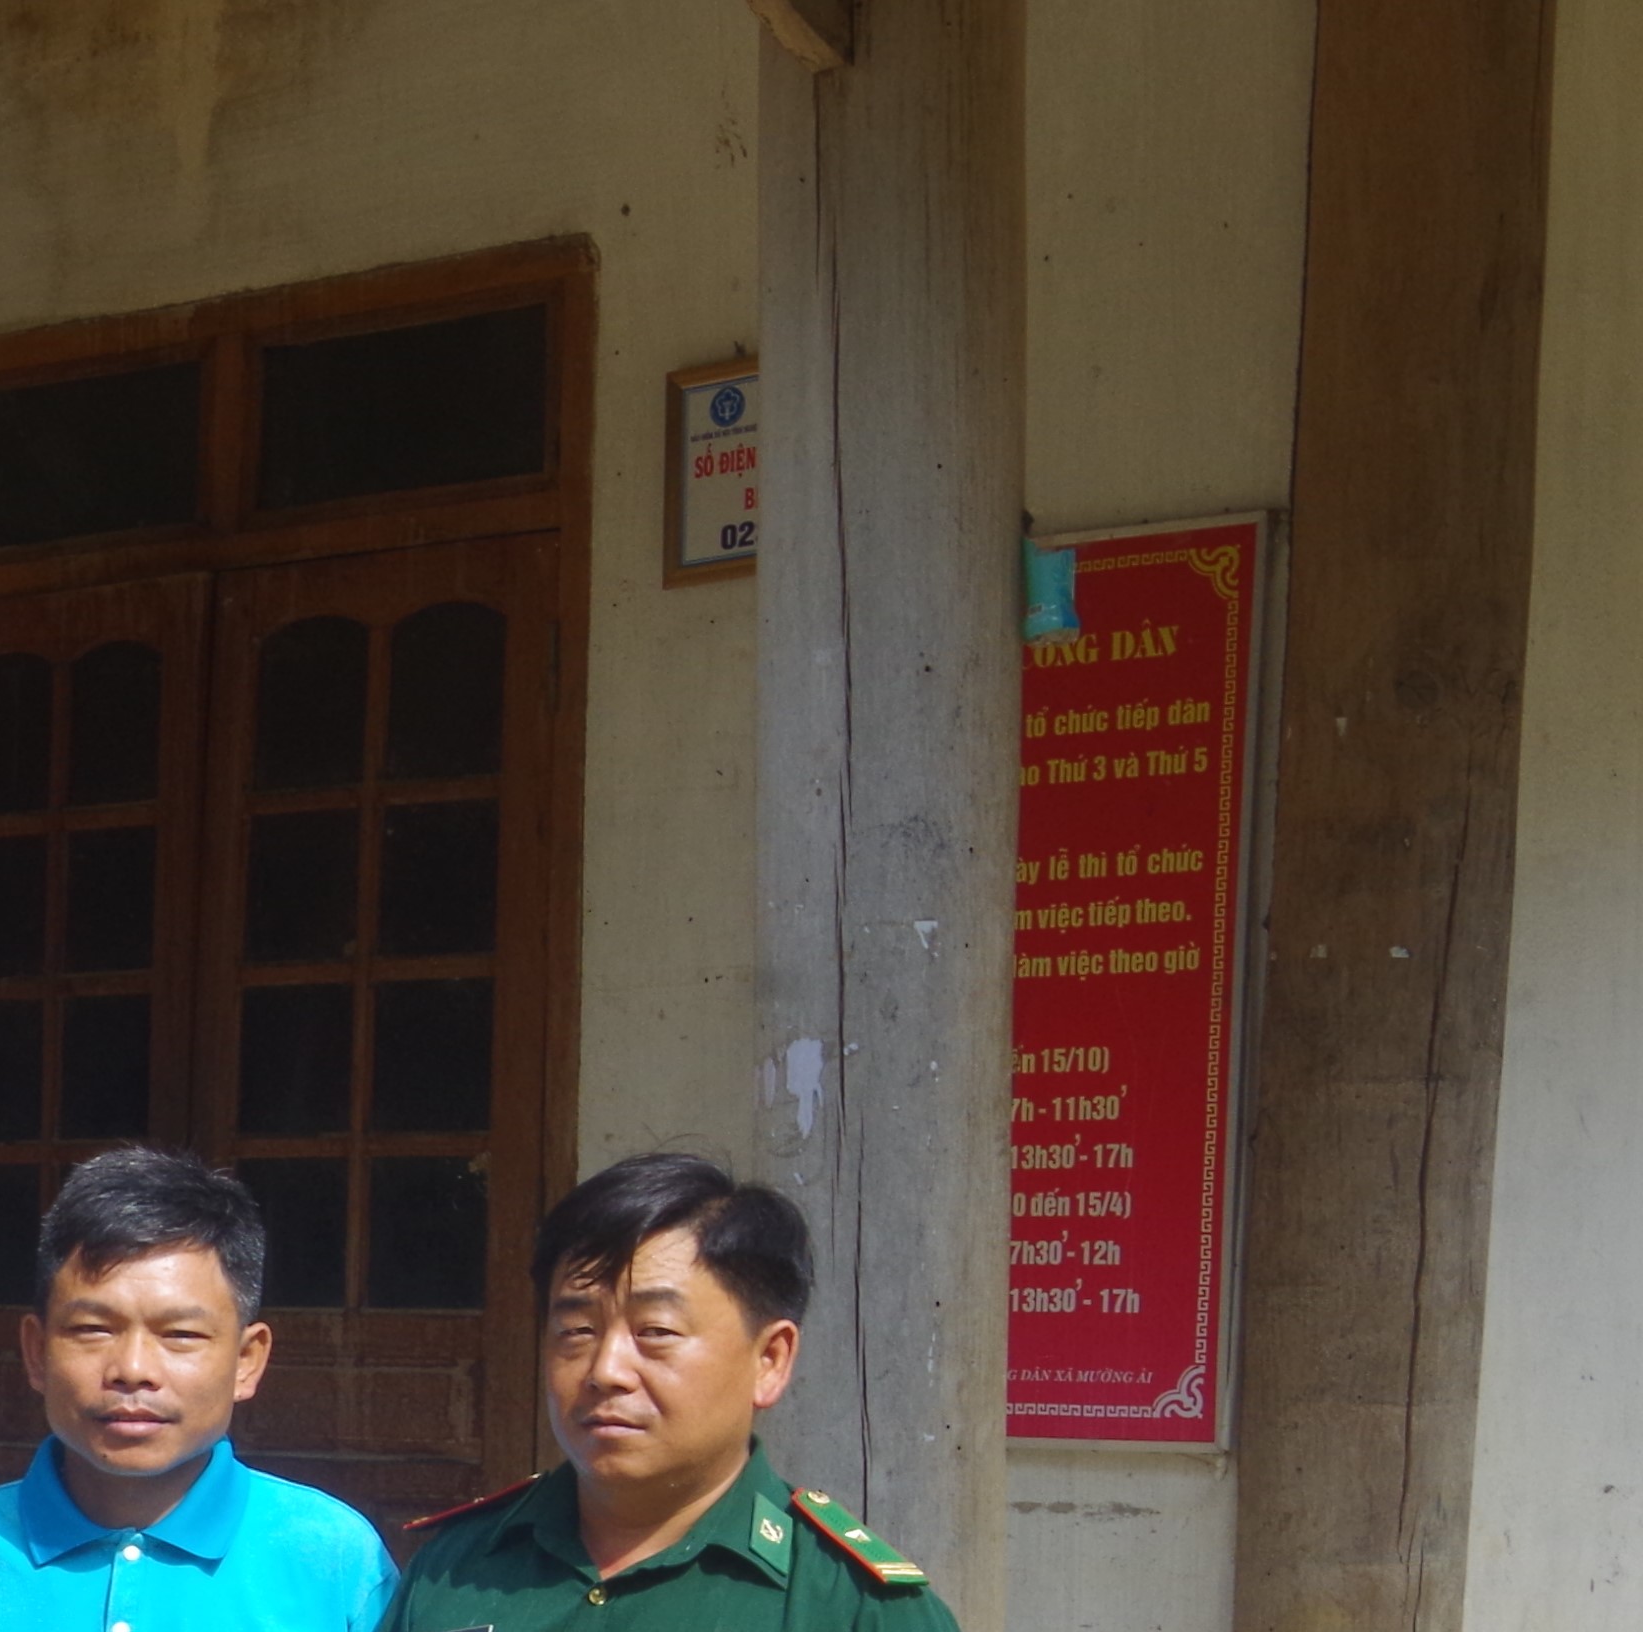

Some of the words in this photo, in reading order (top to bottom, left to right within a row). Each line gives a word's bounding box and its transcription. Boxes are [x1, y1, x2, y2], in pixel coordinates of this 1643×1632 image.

[695, 443, 715, 479] SỐ
[719, 443, 756, 477] ĐIỆN
[1109, 618, 1180, 662] DÂN
[1025, 705, 1050, 739] tổ
[1053, 703, 1109, 736] chức
[1115, 697, 1160, 731] tiếp
[1167, 696, 1211, 726] dân
[1046, 753, 1088, 785] Thứ
[1092, 754, 1107, 781] 3
[1112, 751, 1140, 780] và
[1146, 744, 1189, 777] Thứ
[1193, 746, 1209, 773] 5
[1048, 847, 1070, 881] lễ
[1116, 843, 1142, 877] tổ
[1147, 843, 1204, 875] chức
[1037, 901, 1084, 934] việc
[1088, 895, 1132, 929] tiếp
[1135, 898, 1193, 925] theo.
[1057, 948, 1104, 982] việc
[1109, 948, 1159, 975] theo
[1163, 940, 1201, 976] giờ
[1040, 1045, 1110, 1075] 15/10)
[1093, 1142, 1134, 1169] 17h
[1029, 1187, 1071, 1217] đến
[1075, 1191, 1132, 1220] 15/4)
[1080, 1240, 1122, 1266] 12h
[1099, 1288, 1141, 1314] 17h
[1020, 1366, 1052, 1382] DÂN
[1053, 1367, 1074, 1382] XÃ
[1075, 1367, 1135, 1385] MƯỜNG
